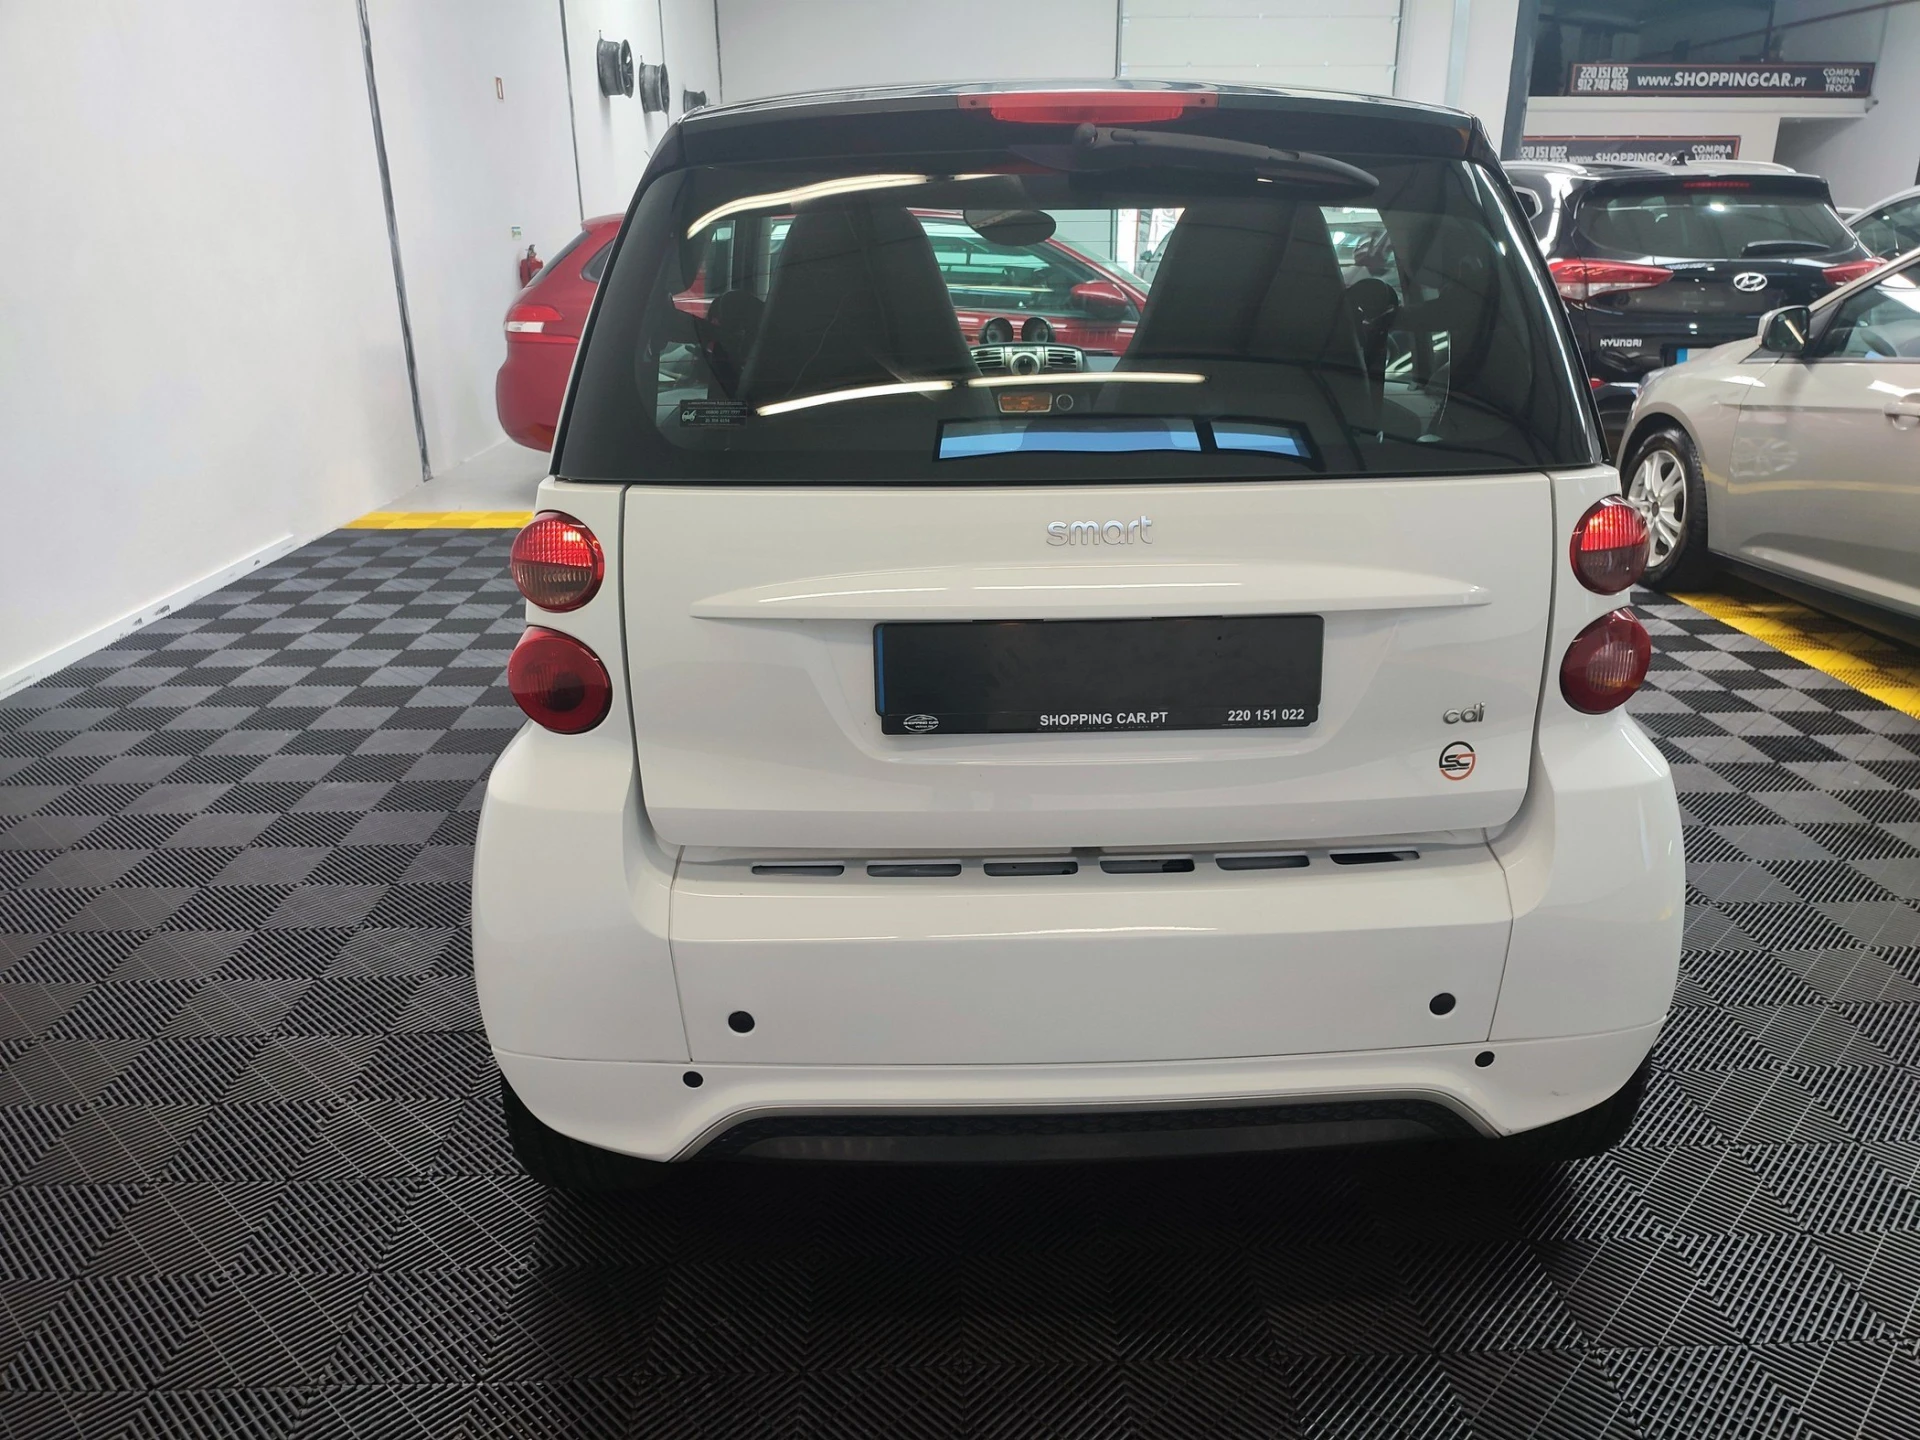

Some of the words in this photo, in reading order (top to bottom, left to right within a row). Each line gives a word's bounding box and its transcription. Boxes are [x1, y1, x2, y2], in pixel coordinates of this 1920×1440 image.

[1580, 67, 1597, 78] 220
[1598, 67, 1610, 78] 151
[1611, 67, 1629, 78] 022
[1823, 68, 1861, 77] COMPRA
[1577, 79, 1593, 90] 912
[1825, 84, 1854, 92] TROCA
[1536, 146, 1548, 158] 151
[1550, 146, 1567, 158] 022
[1691, 145, 1732, 153] COMPRA
[1600, 339, 1642, 347] HYUNDAI
[1046, 515, 1153, 546] smart
[1228, 710, 1251, 721] 220
[1255, 709, 1277, 720] 151
[1281, 709, 1305, 720] 022
[1443, 701, 1486, 724] cdi
[1040, 713, 1112, 726] SHOPPING
[1116, 712, 1168, 724] CAR.PT
